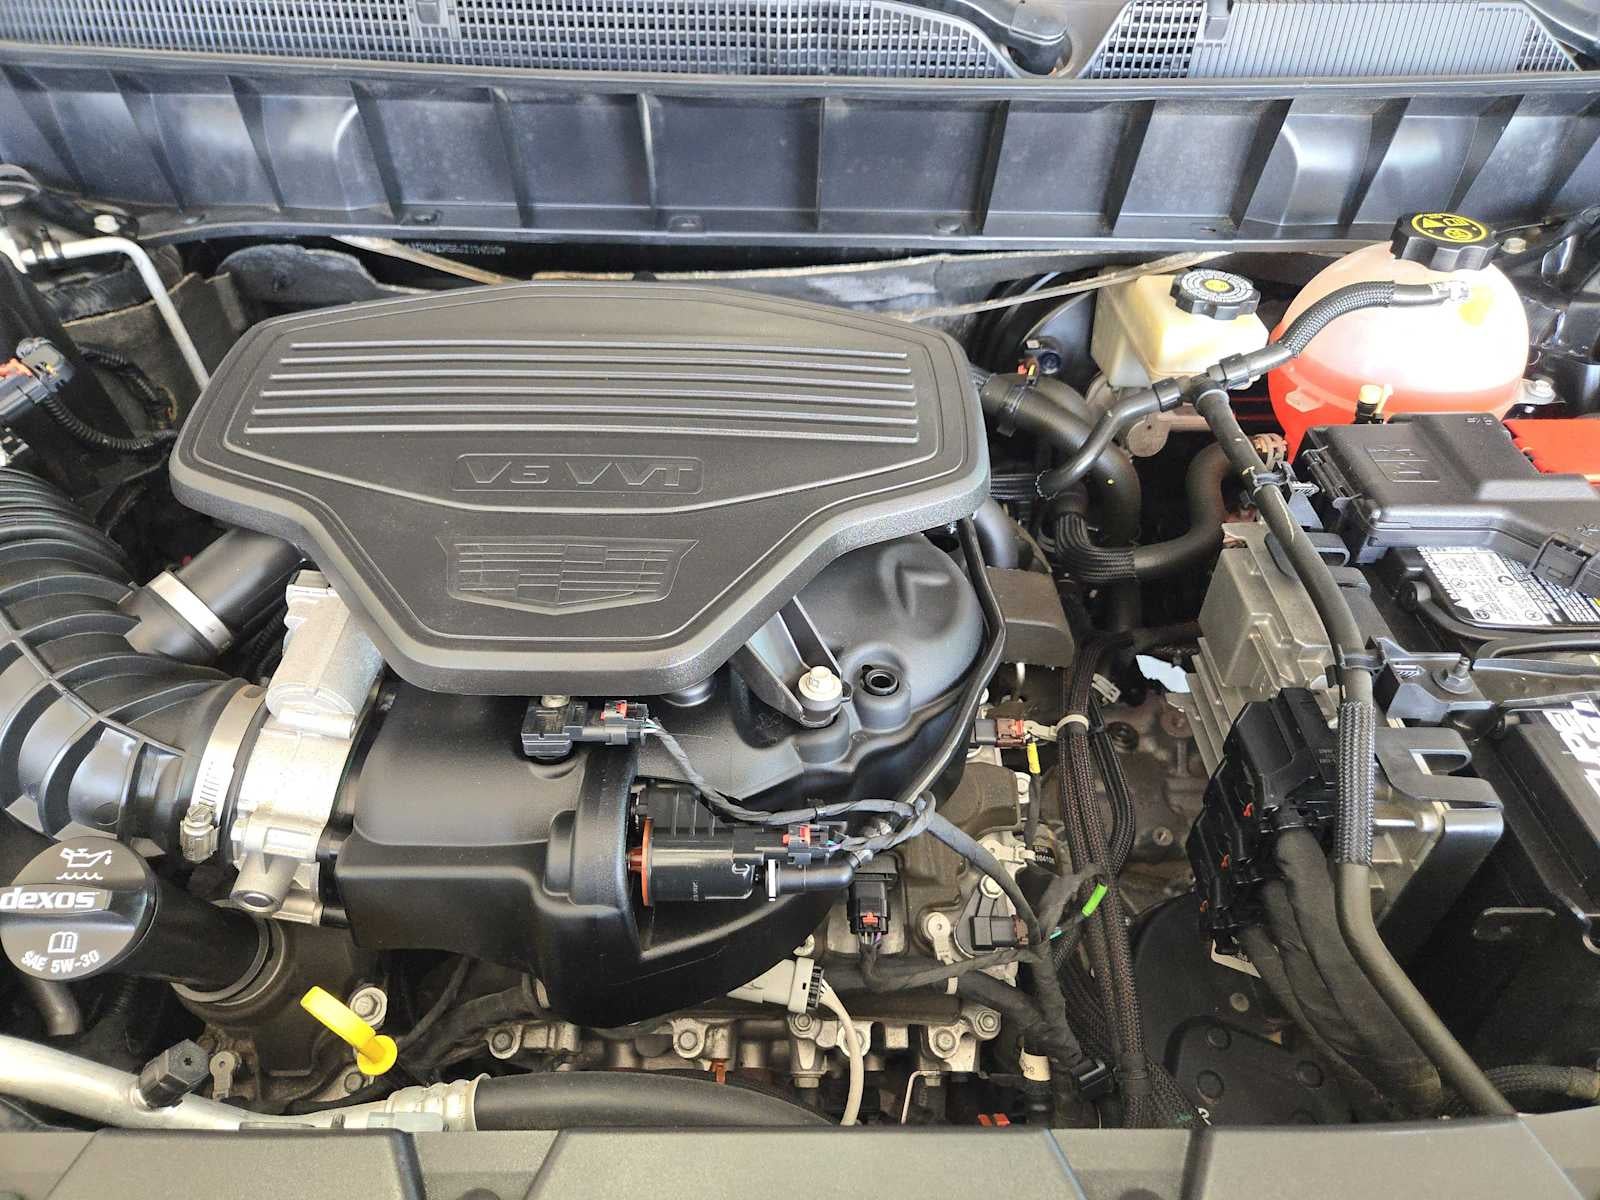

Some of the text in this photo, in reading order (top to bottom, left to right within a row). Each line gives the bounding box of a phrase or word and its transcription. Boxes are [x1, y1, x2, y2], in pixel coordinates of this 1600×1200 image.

[466, 461, 695, 487] V6 VVT
[0, 886, 97, 911] dexos
[20, 950, 101, 974] SAE 5W-30
